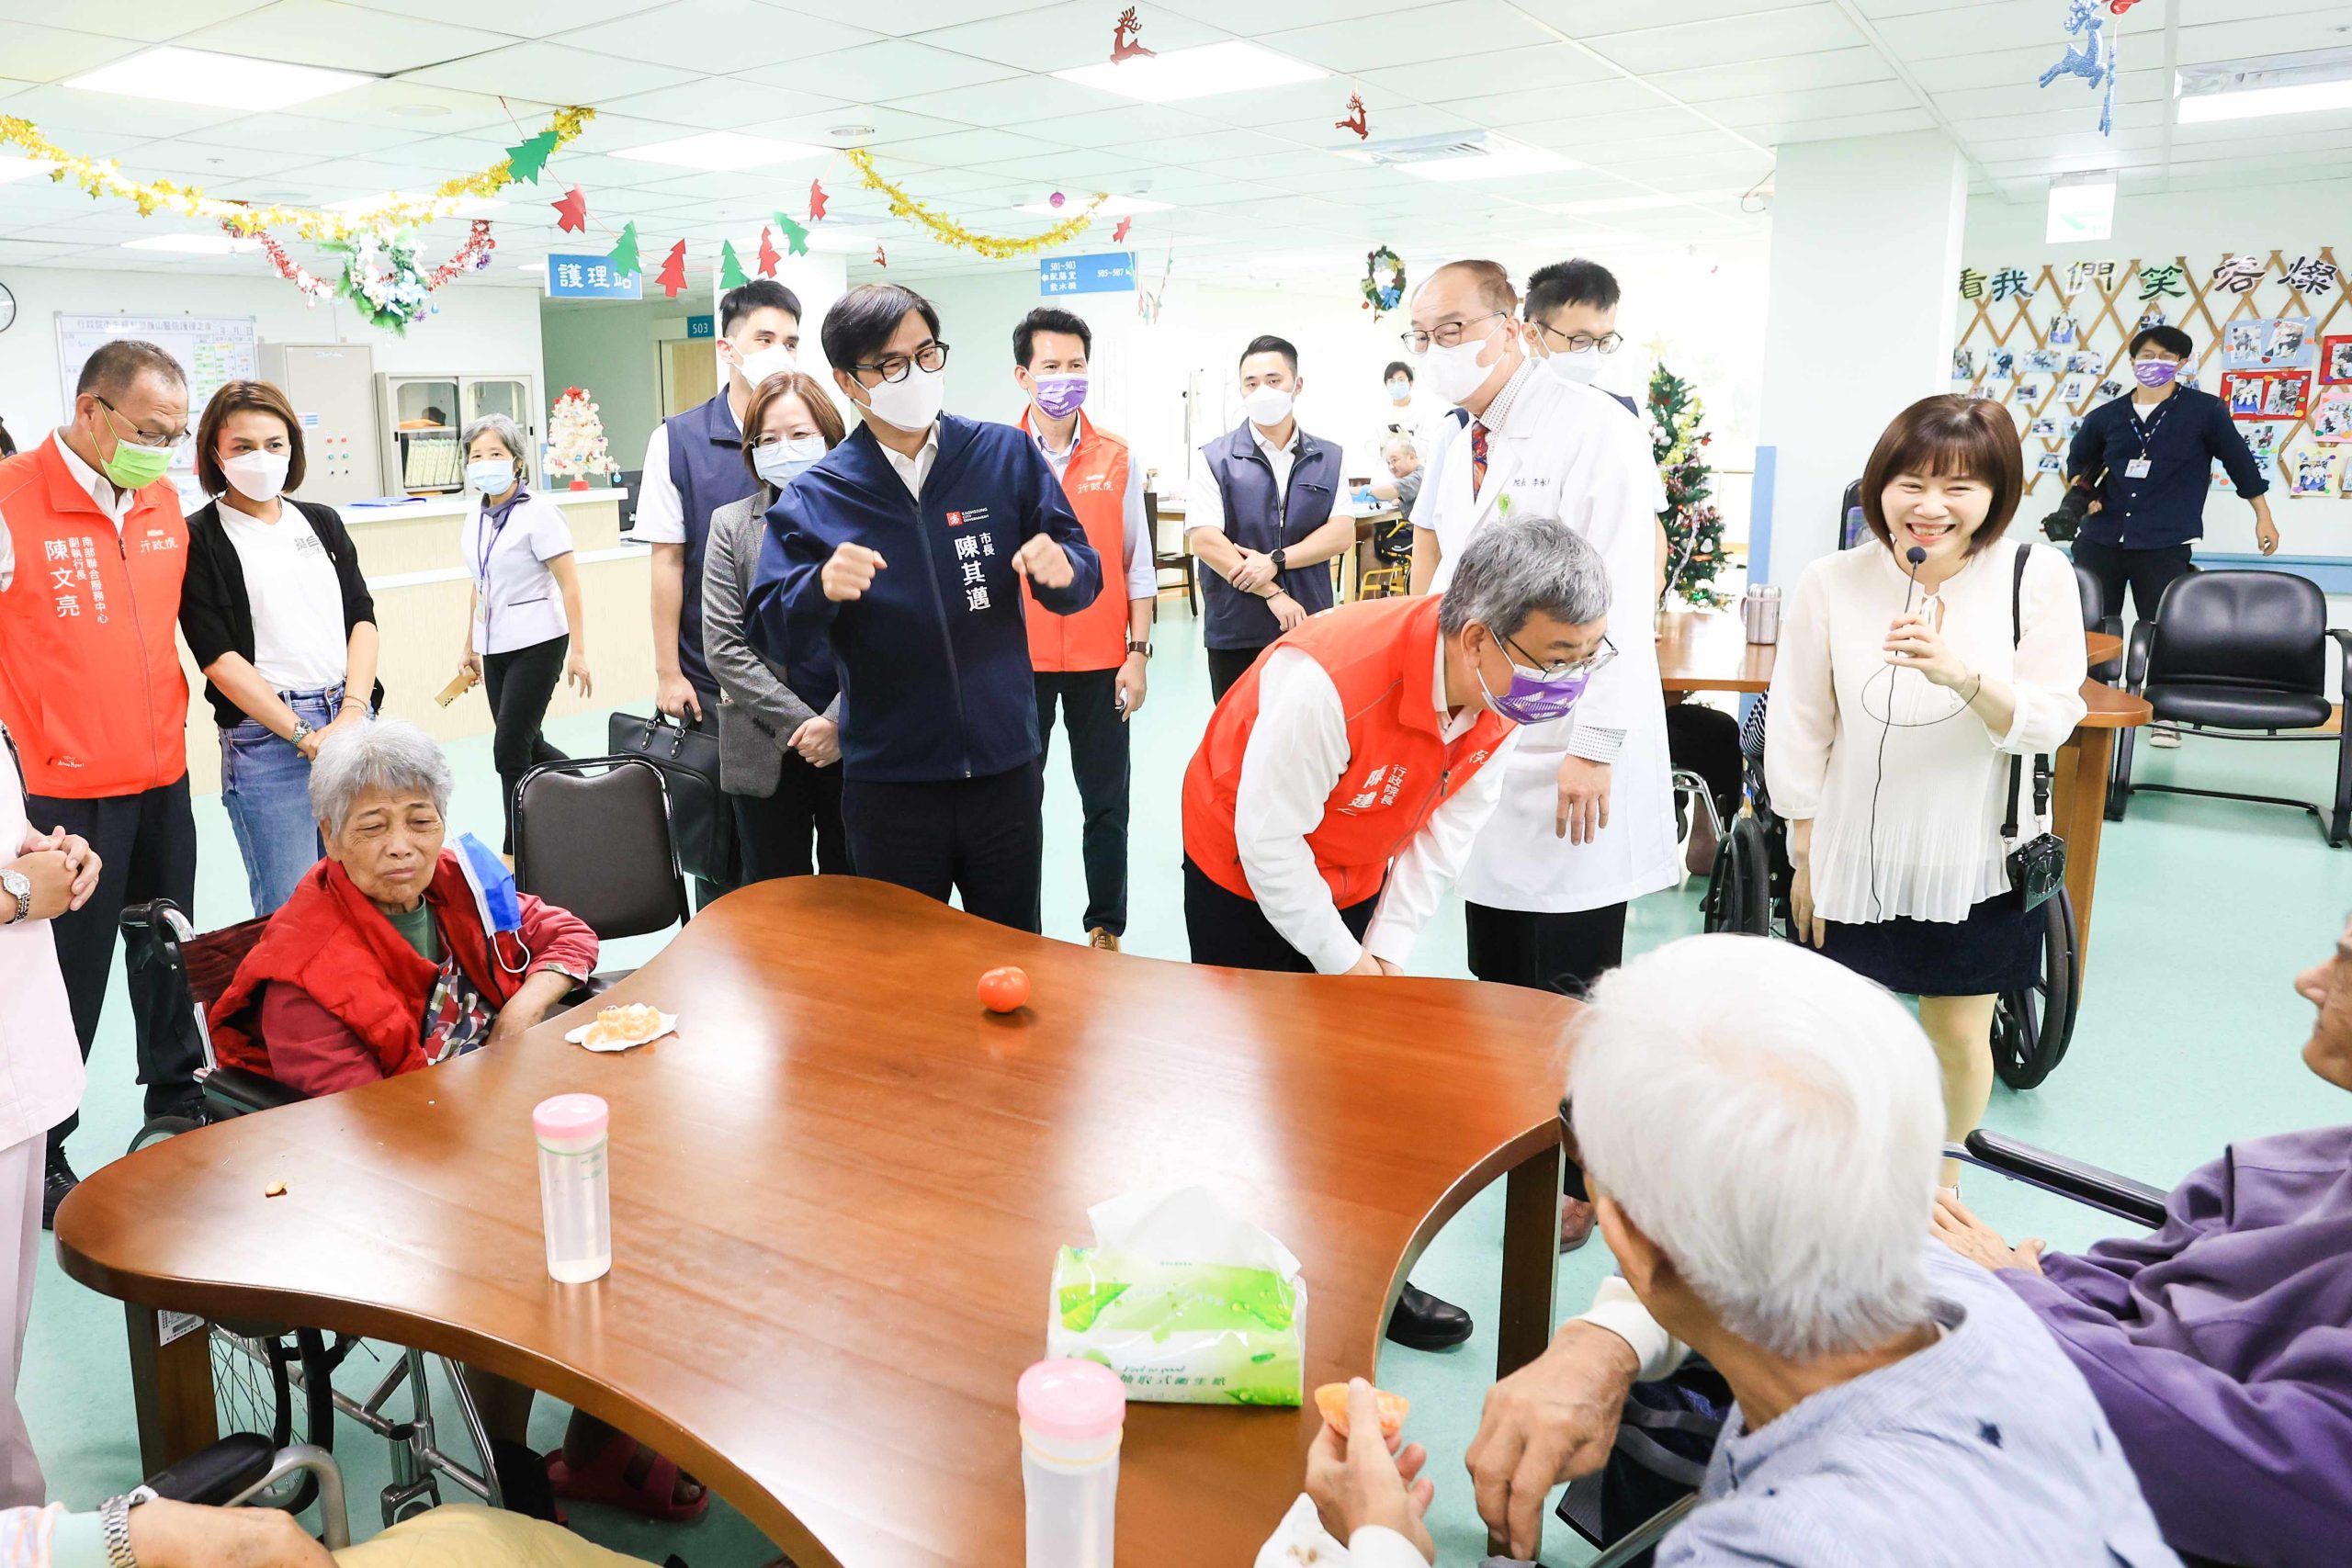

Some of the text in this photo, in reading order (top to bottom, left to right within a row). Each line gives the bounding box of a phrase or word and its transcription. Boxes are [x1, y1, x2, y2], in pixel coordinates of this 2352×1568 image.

[692, 322, 708, 334] 503
[1077, 480, 1114, 494] 行政院
[68, 536, 87, 581] 副執行長
[140, 536, 178, 554] 行政院
[979, 532, 995, 557] 市長
[44, 539, 80, 617] 陳文亮
[82, 536, 108, 625] 南部聯合服務中心
[954, 535, 991, 612] 陳其邁
[1381, 763, 1408, 806] 行政院長
